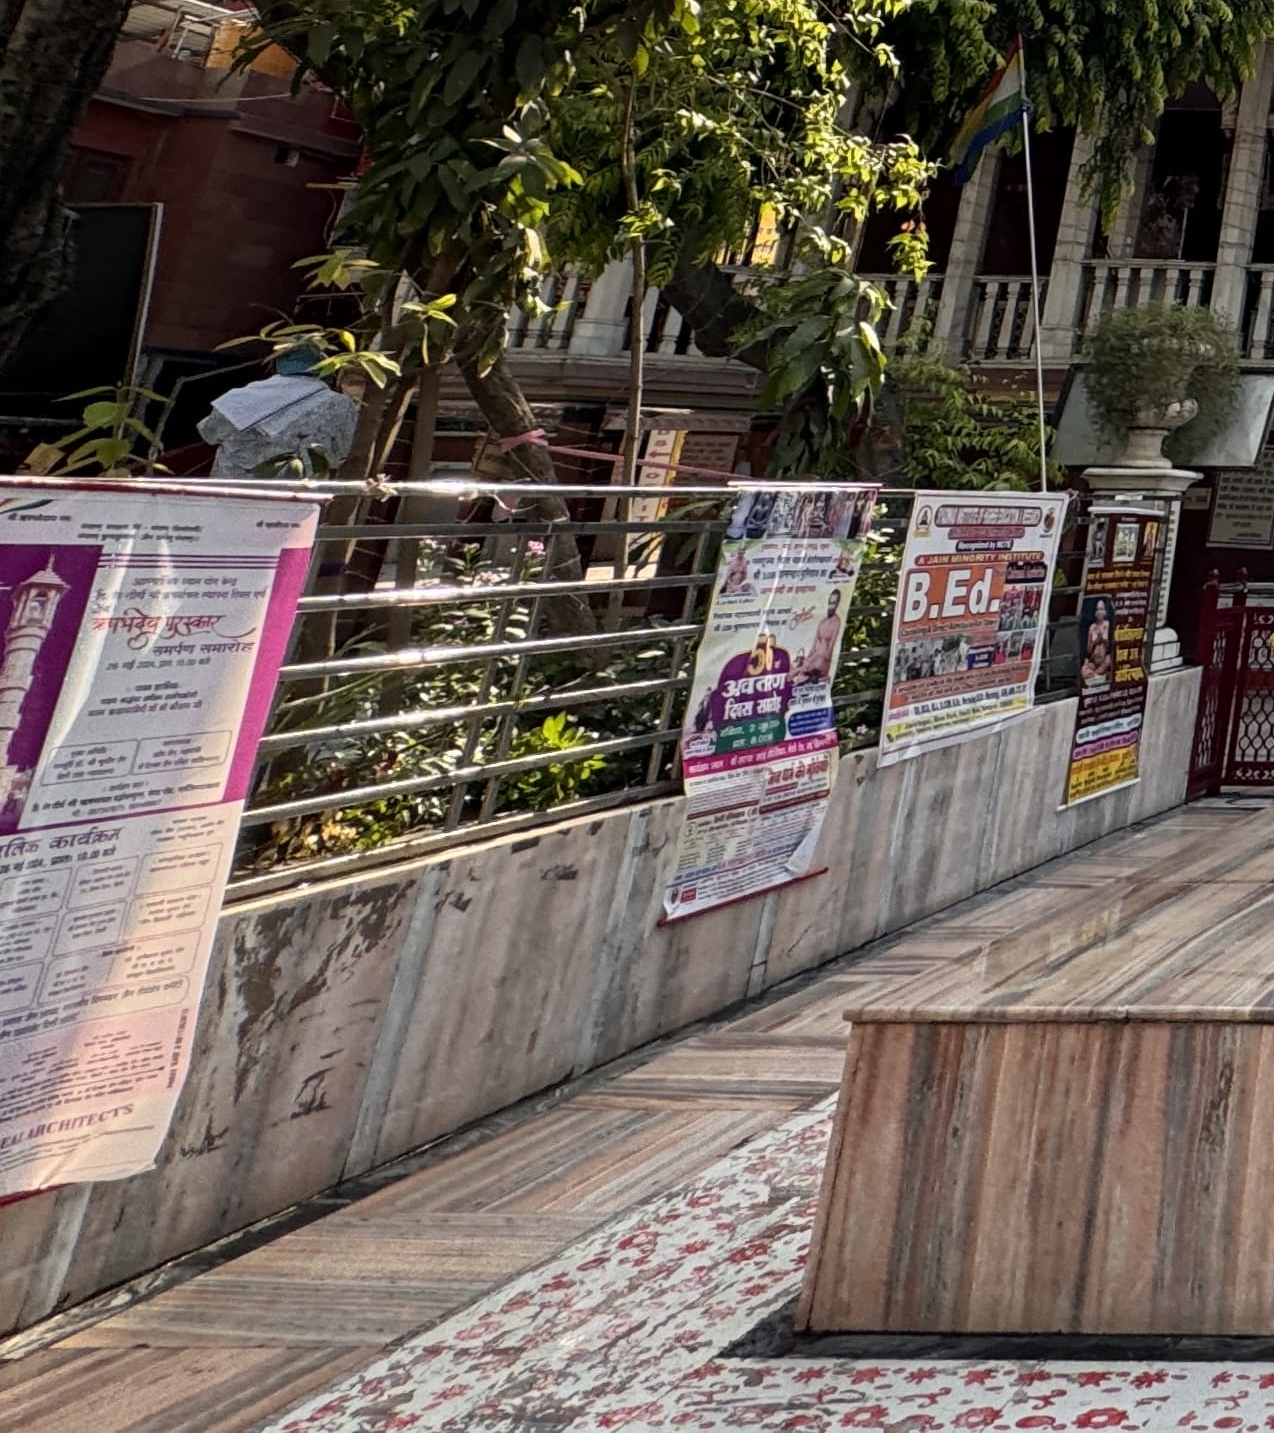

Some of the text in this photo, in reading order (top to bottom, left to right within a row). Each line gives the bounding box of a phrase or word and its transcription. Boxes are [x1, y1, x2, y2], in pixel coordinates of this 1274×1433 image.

[917, 551, 1042, 565] A JAIN MINORITY INSTITUTE
[902, 567, 1000, 623] B.Ed.
